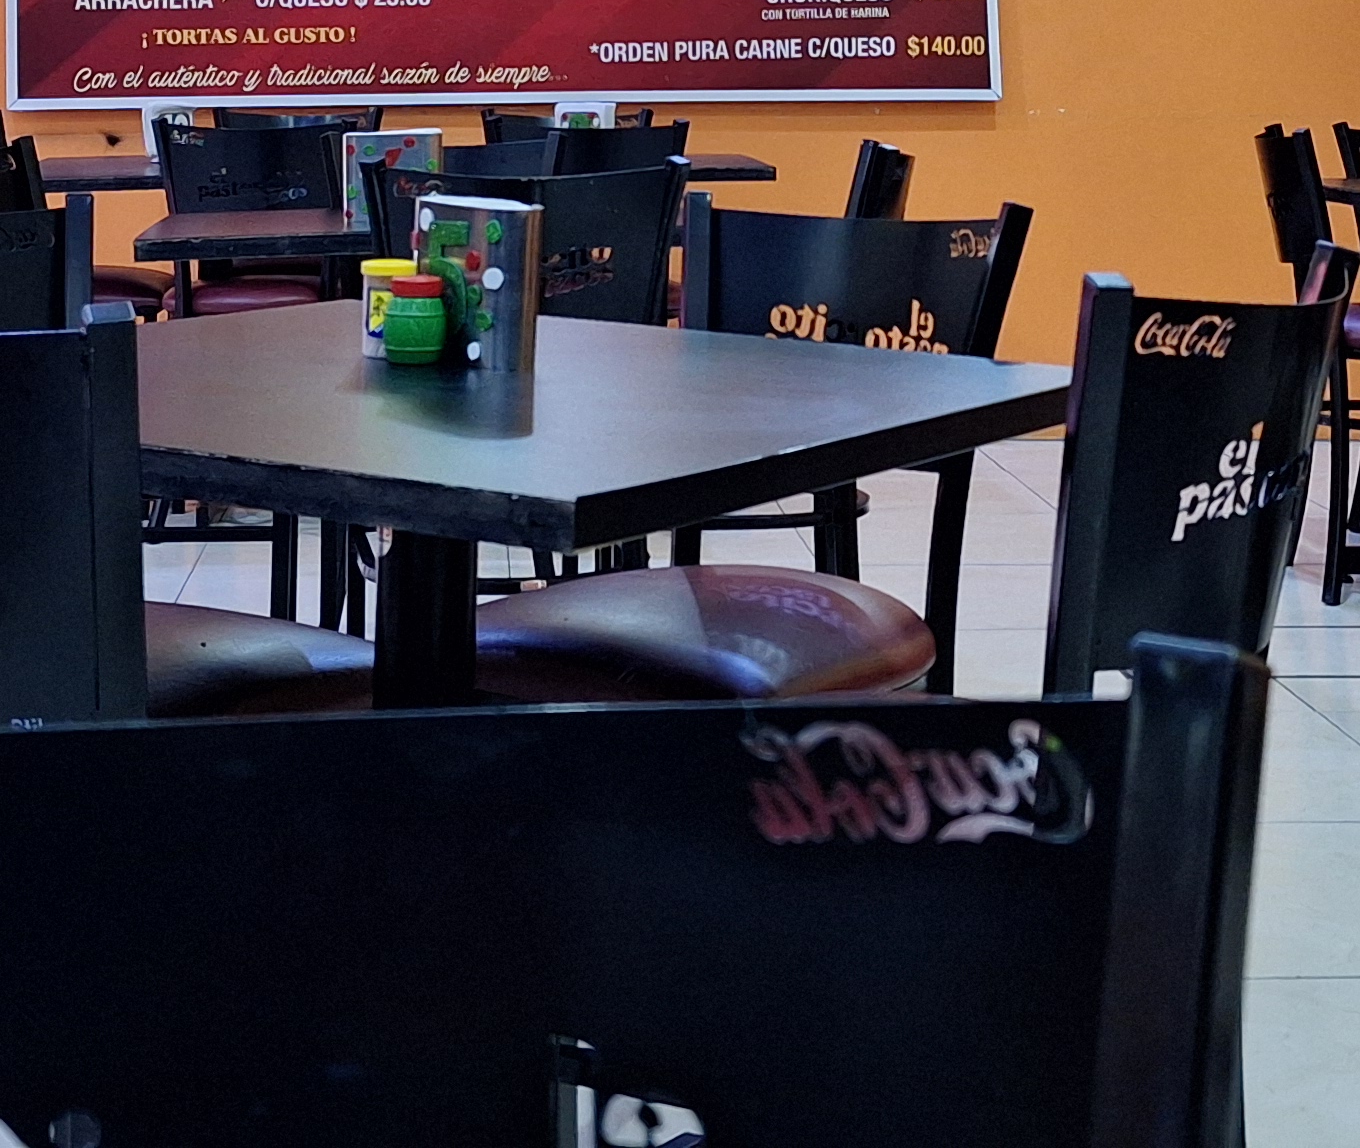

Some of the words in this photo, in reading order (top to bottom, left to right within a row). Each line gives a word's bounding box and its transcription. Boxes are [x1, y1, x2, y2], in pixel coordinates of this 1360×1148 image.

[761, 9, 782, 21] CON
[785, 8, 833, 21] TORTILLA
[835, 8, 849, 20] DE
[152, 29, 237, 46] TORTAS
[242, 28, 270, 45] AL
[274, 26, 345, 44] GUSTO
[675, 39, 730, 62] PURA
[735, 38, 802, 60] CARNE
[808, 34, 896, 58] C/QUESO
[907, 34, 985, 57] $140.00
[72, 66, 117, 93] Con
[122, 65, 143, 88] el
[147, 63, 242, 89] auténtico
[243, 71, 261, 94] y
[267, 63, 375, 88] tradicional
[379, 60, 440, 86] sazón
[444, 60, 471, 85] de
